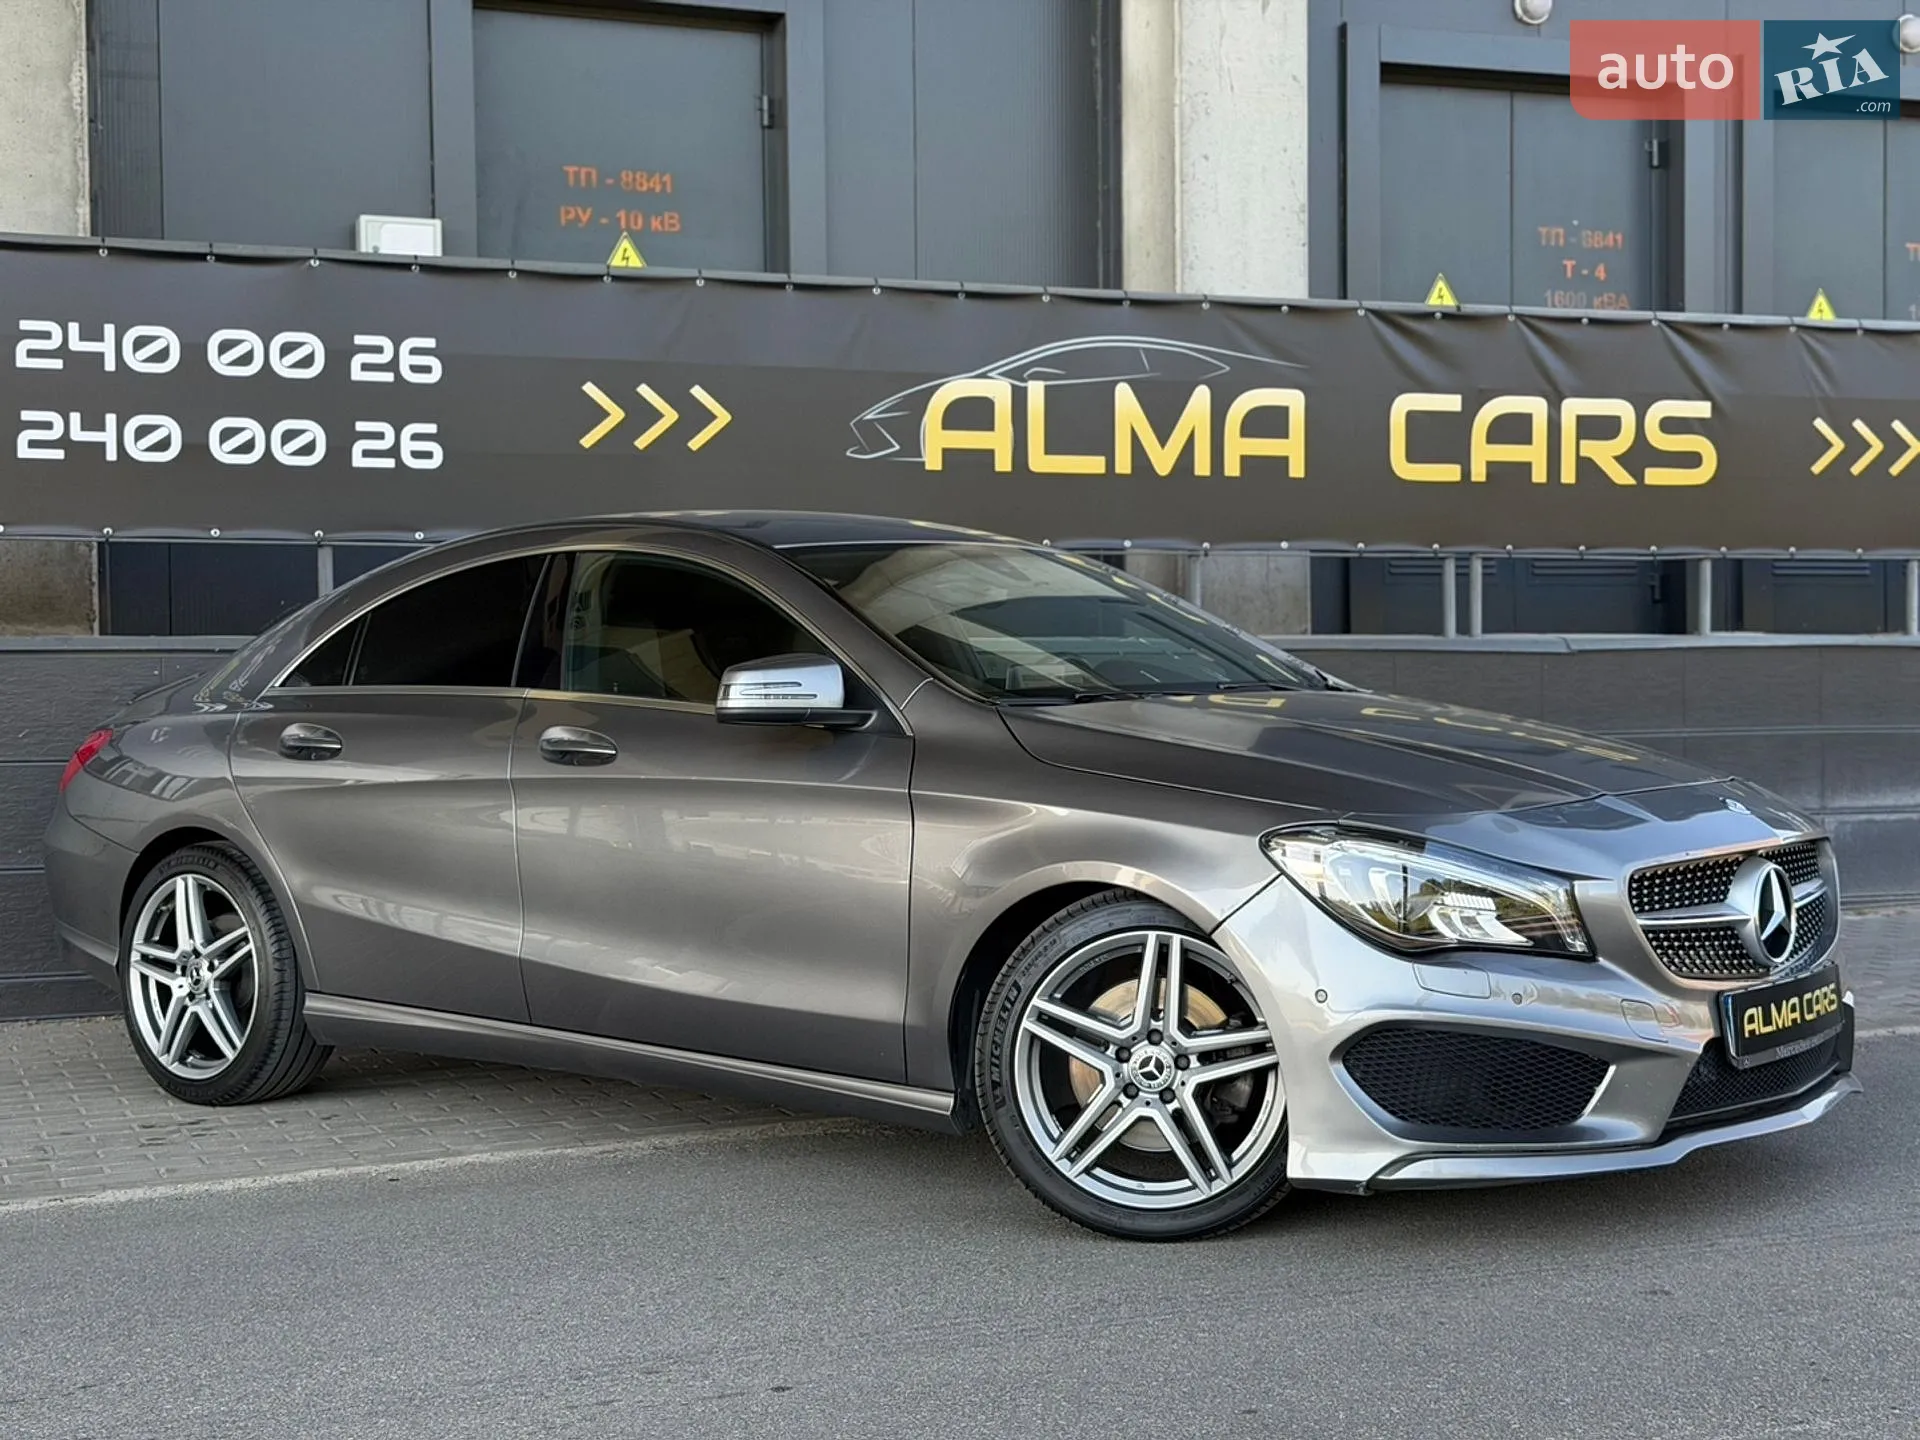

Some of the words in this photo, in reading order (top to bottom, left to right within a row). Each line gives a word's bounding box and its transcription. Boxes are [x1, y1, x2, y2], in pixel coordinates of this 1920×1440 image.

[621, 168, 672, 193] 8841
[616, 208, 643, 231] 10
[1594, 263, 1608, 281] 4
[15, 319, 181, 374] 240
[207, 329, 326, 380] 00
[350, 334, 443, 384] 26
[16, 410, 182, 463] 240
[208, 416, 327, 467] 00
[351, 421, 444, 469] 26
[924, 379, 1307, 478] ALMA
[1390, 393, 1718, 487] CARS
[1744, 996, 1801, 1038] ALMA
[1803, 983, 1838, 1021] CARS
